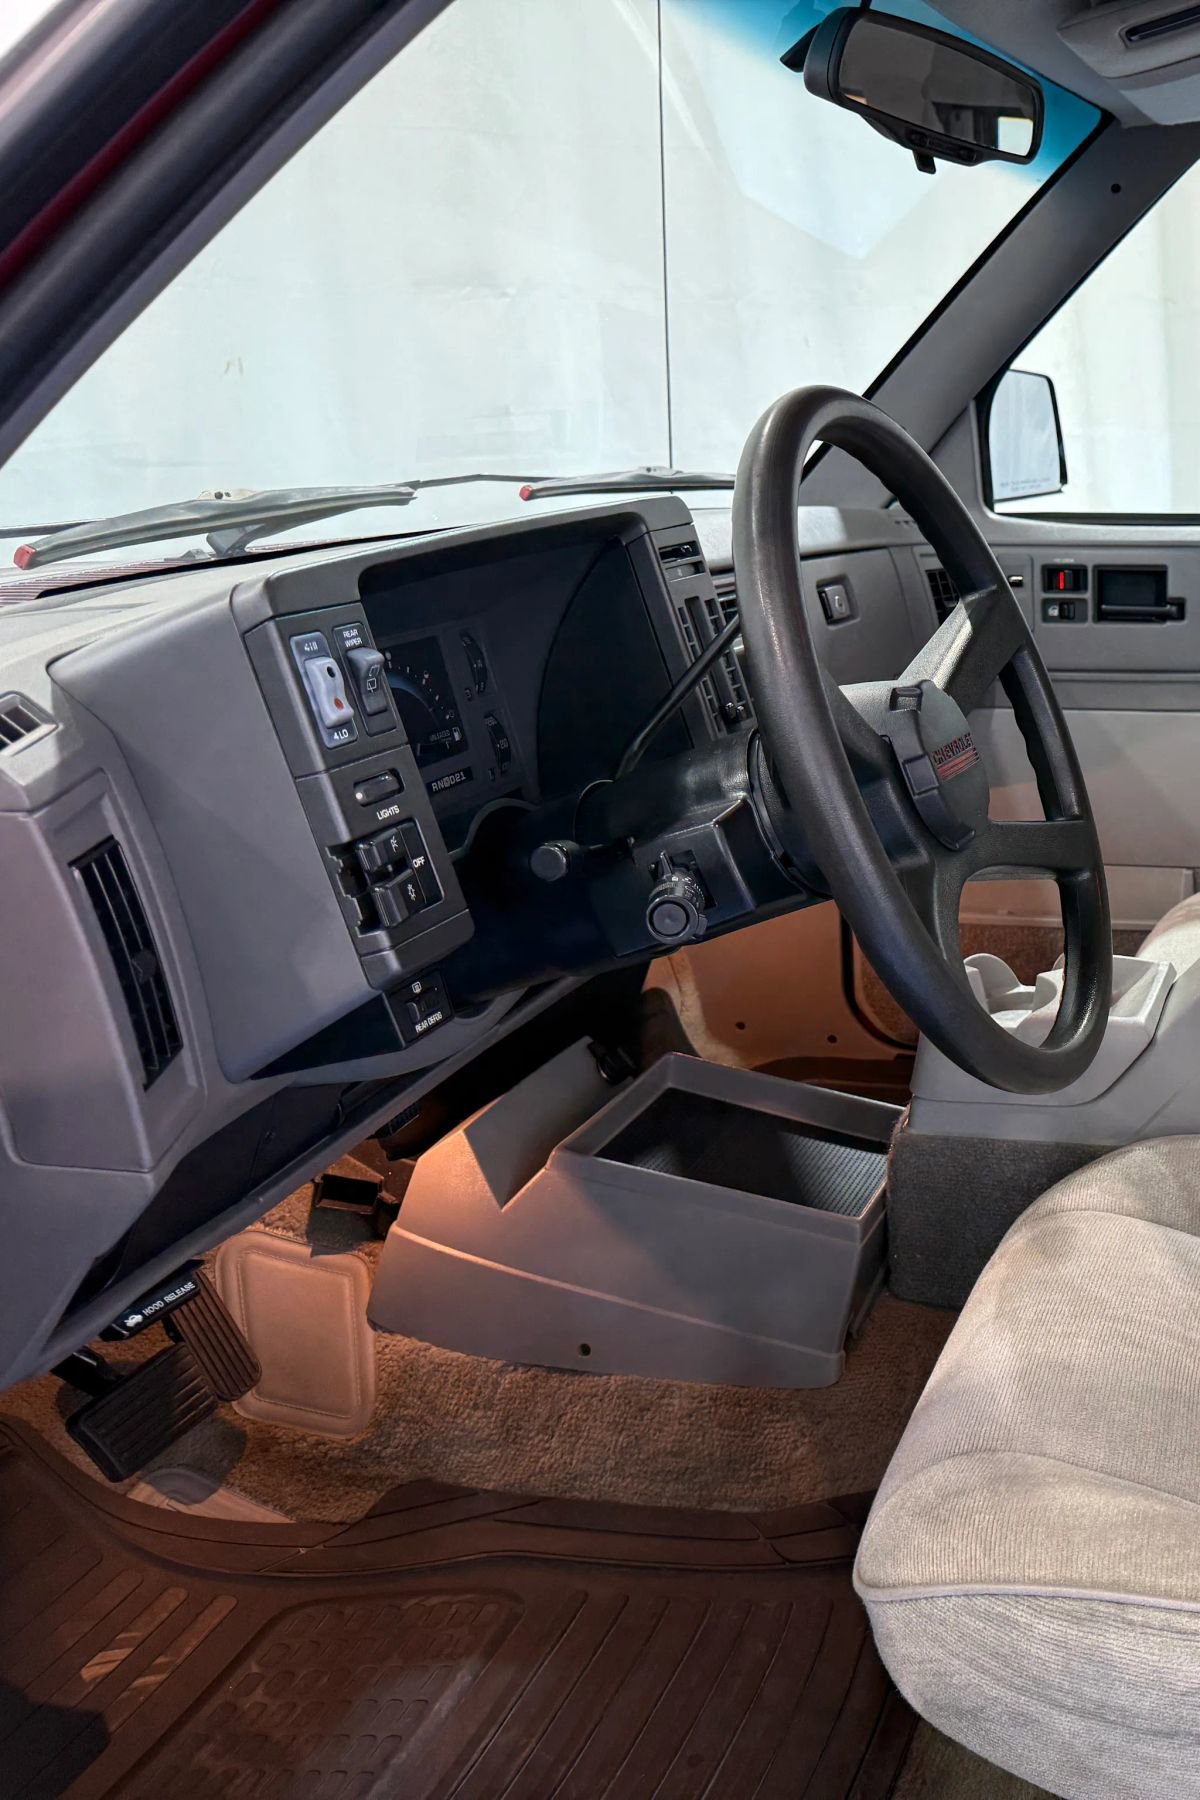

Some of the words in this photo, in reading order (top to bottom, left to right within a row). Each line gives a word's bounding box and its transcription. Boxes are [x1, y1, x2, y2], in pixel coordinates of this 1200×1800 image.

[343, 628, 358, 638] REAR
[345, 637, 362, 647] WIPER
[376, 805, 400, 820] LIGHTS
[412, 856, 425, 868] OFF
[415, 1019, 429, 1033] REAR
[427, 1011, 443, 1026] DEFOG
[142, 1300, 164, 1316] HOOD
[163, 1281, 196, 1304] RELEASE
